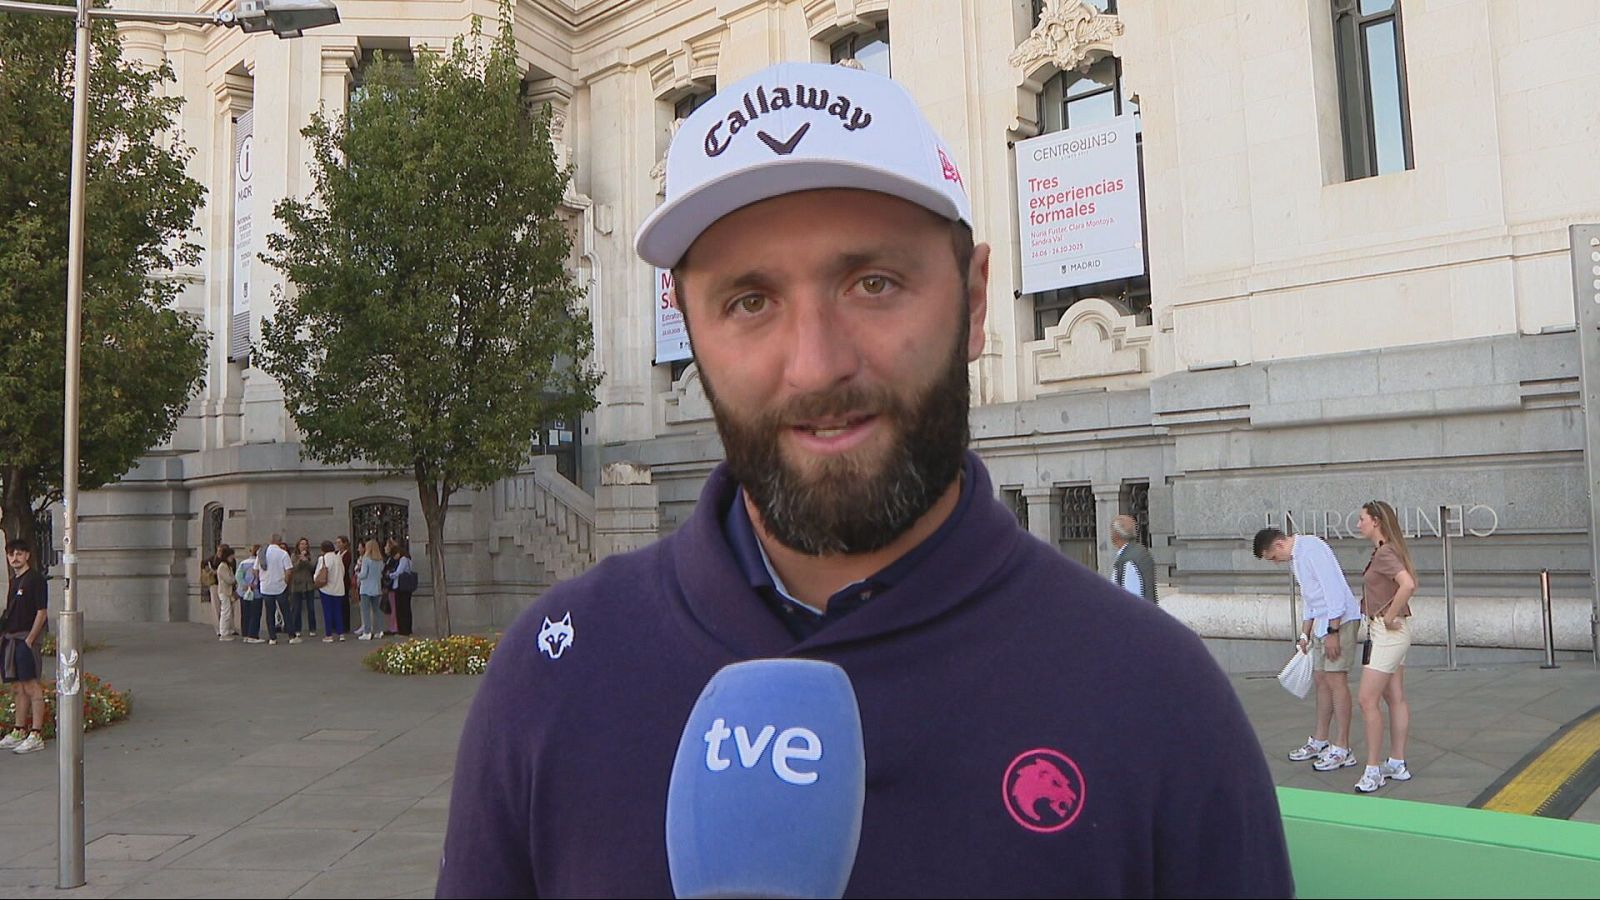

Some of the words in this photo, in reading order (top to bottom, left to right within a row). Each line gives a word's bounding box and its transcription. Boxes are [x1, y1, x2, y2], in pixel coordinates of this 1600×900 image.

[704, 84, 872, 157] Callaway
[1028, 176, 1059, 193] Tres
[1029, 178, 1124, 209] experiencias
[237, 185, 252, 203] MADR
[1030, 202, 1096, 226] formales
[1031, 237, 1052, 247] Sandra
[1052, 235, 1063, 244] Val
[1070, 259, 1101, 272] MADRID
[661, 273, 674, 290] M
[704, 718, 823, 785] tve
